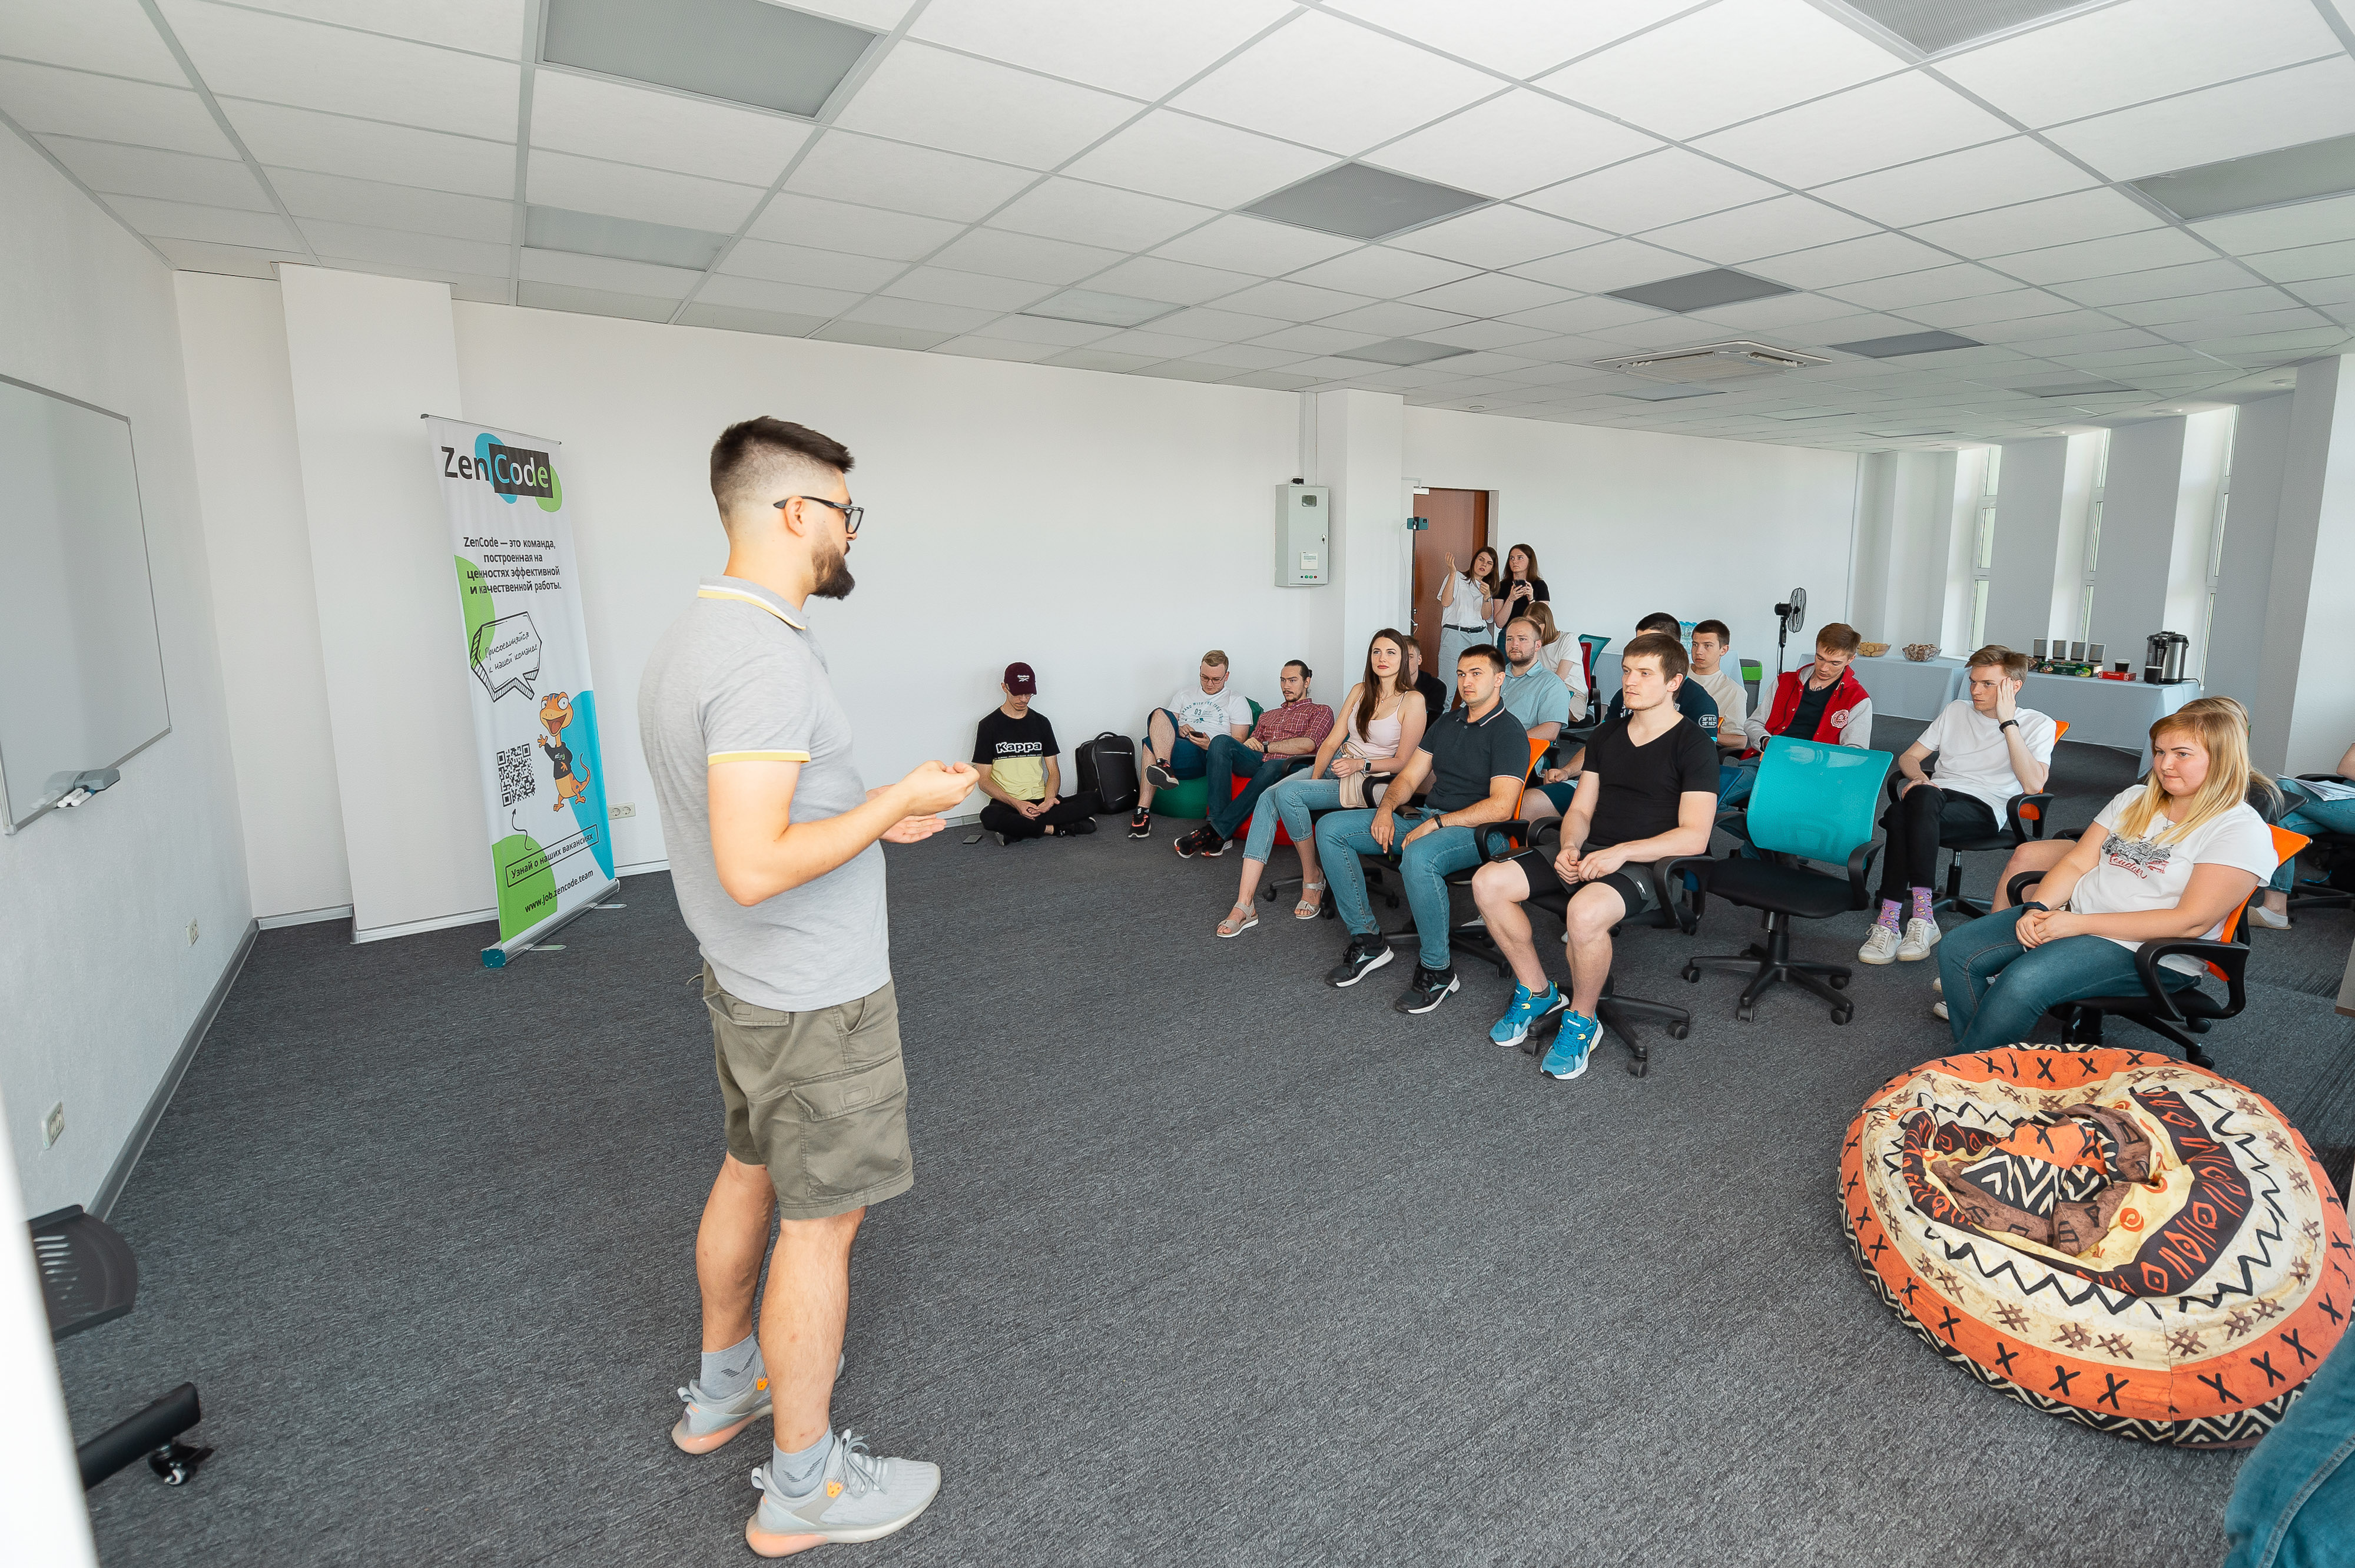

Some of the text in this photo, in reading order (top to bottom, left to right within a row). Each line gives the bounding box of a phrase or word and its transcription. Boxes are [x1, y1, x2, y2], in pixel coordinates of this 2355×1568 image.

[441, 446, 549, 488] ZenCode
[463, 537, 499, 548] ZenCode
[509, 539, 521, 548] это
[523, 539, 556, 550] команда,
[483, 554, 533, 565] построенная
[467, 566, 560, 581] ценностях эффективной
[470, 581, 562, 595] и качественной работы.
[485, 631, 529, 661] Присоединяйся
[495, 653, 512, 670] нашей
[996, 741, 1042, 754] Kappa
[511, 860, 533, 879] Узнай
[539, 848, 562, 865] наших
[562, 833, 594, 854] вакансиях
[525, 870, 594, 913] www.job.zencode.team
